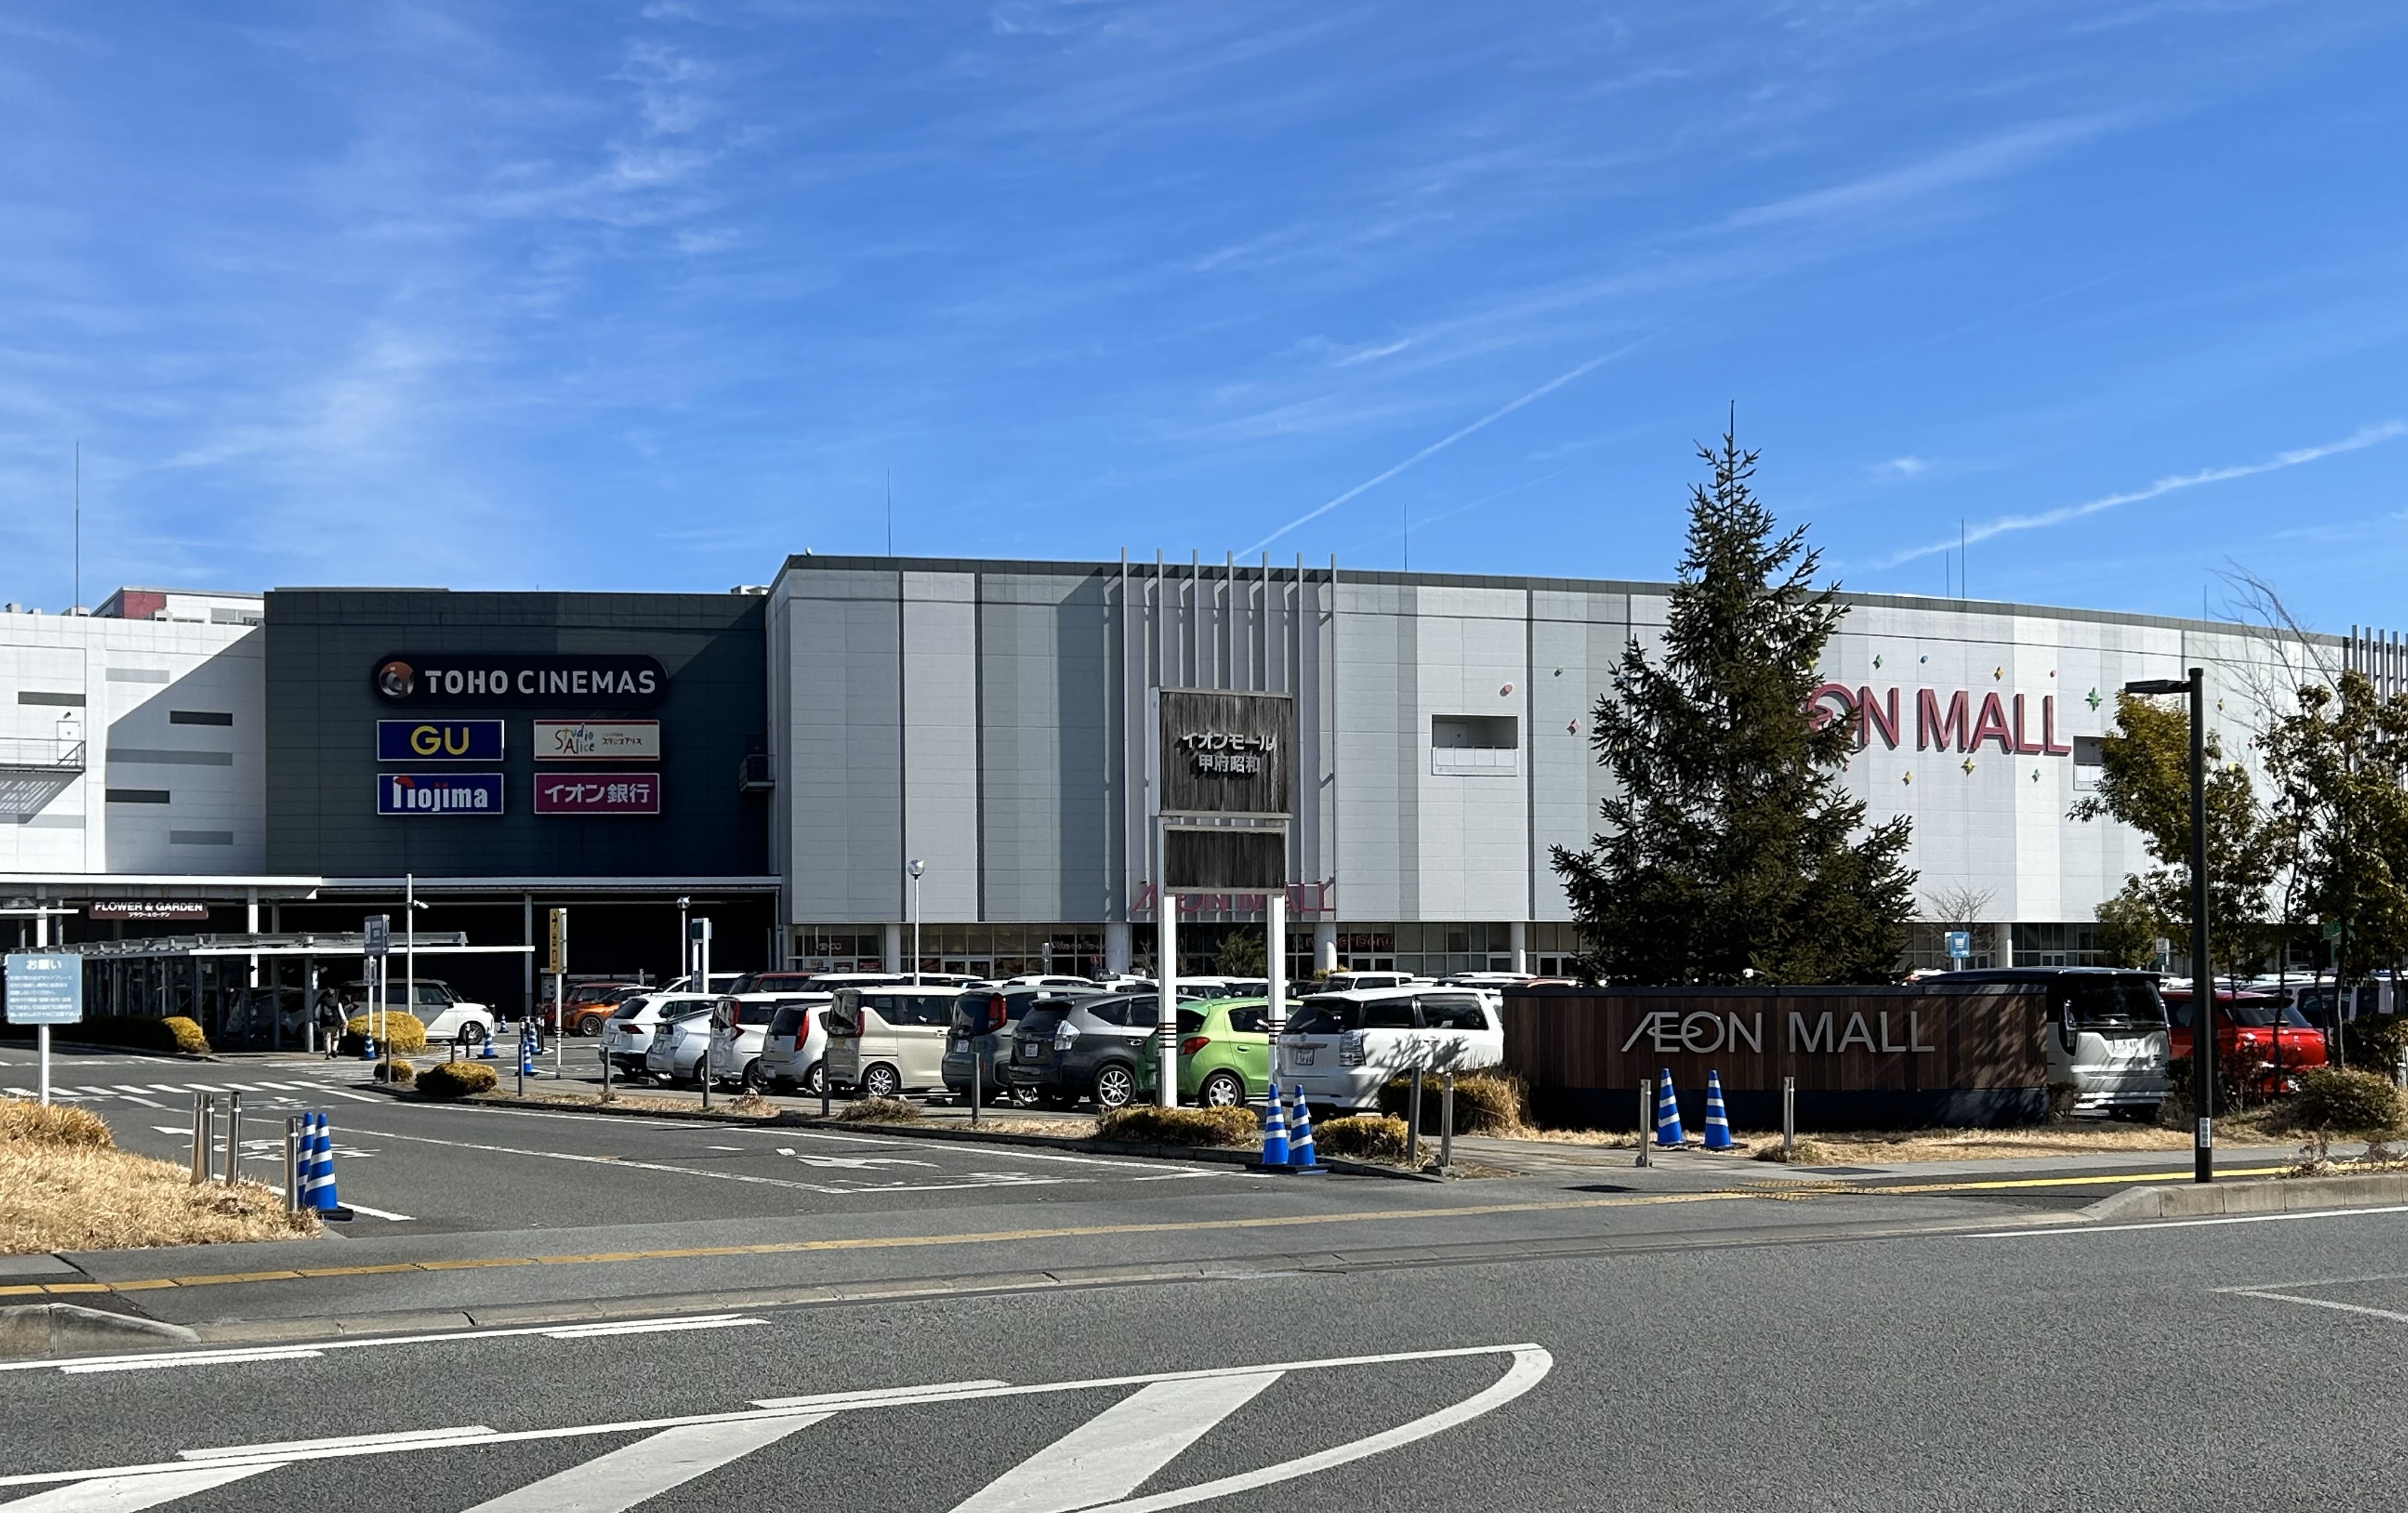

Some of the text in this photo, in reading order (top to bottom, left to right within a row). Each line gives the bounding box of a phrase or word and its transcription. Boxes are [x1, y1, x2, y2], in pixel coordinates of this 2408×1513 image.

[425, 670, 655, 694] TOHO CINEMAS
[1917, 688, 2072, 756] MALL
[410, 725, 469, 755] GU
[555, 722, 594, 750] Studio
[563, 738, 595, 755] Alice
[1182, 732, 1276, 751] イオンモール
[1199, 754, 1260, 773] 甲府昭和
[544, 783, 650, 803] イオン銀行
[94, 902, 203, 912] FLOWER & GARDEN
[1788, 1011, 1935, 1053] MALL
